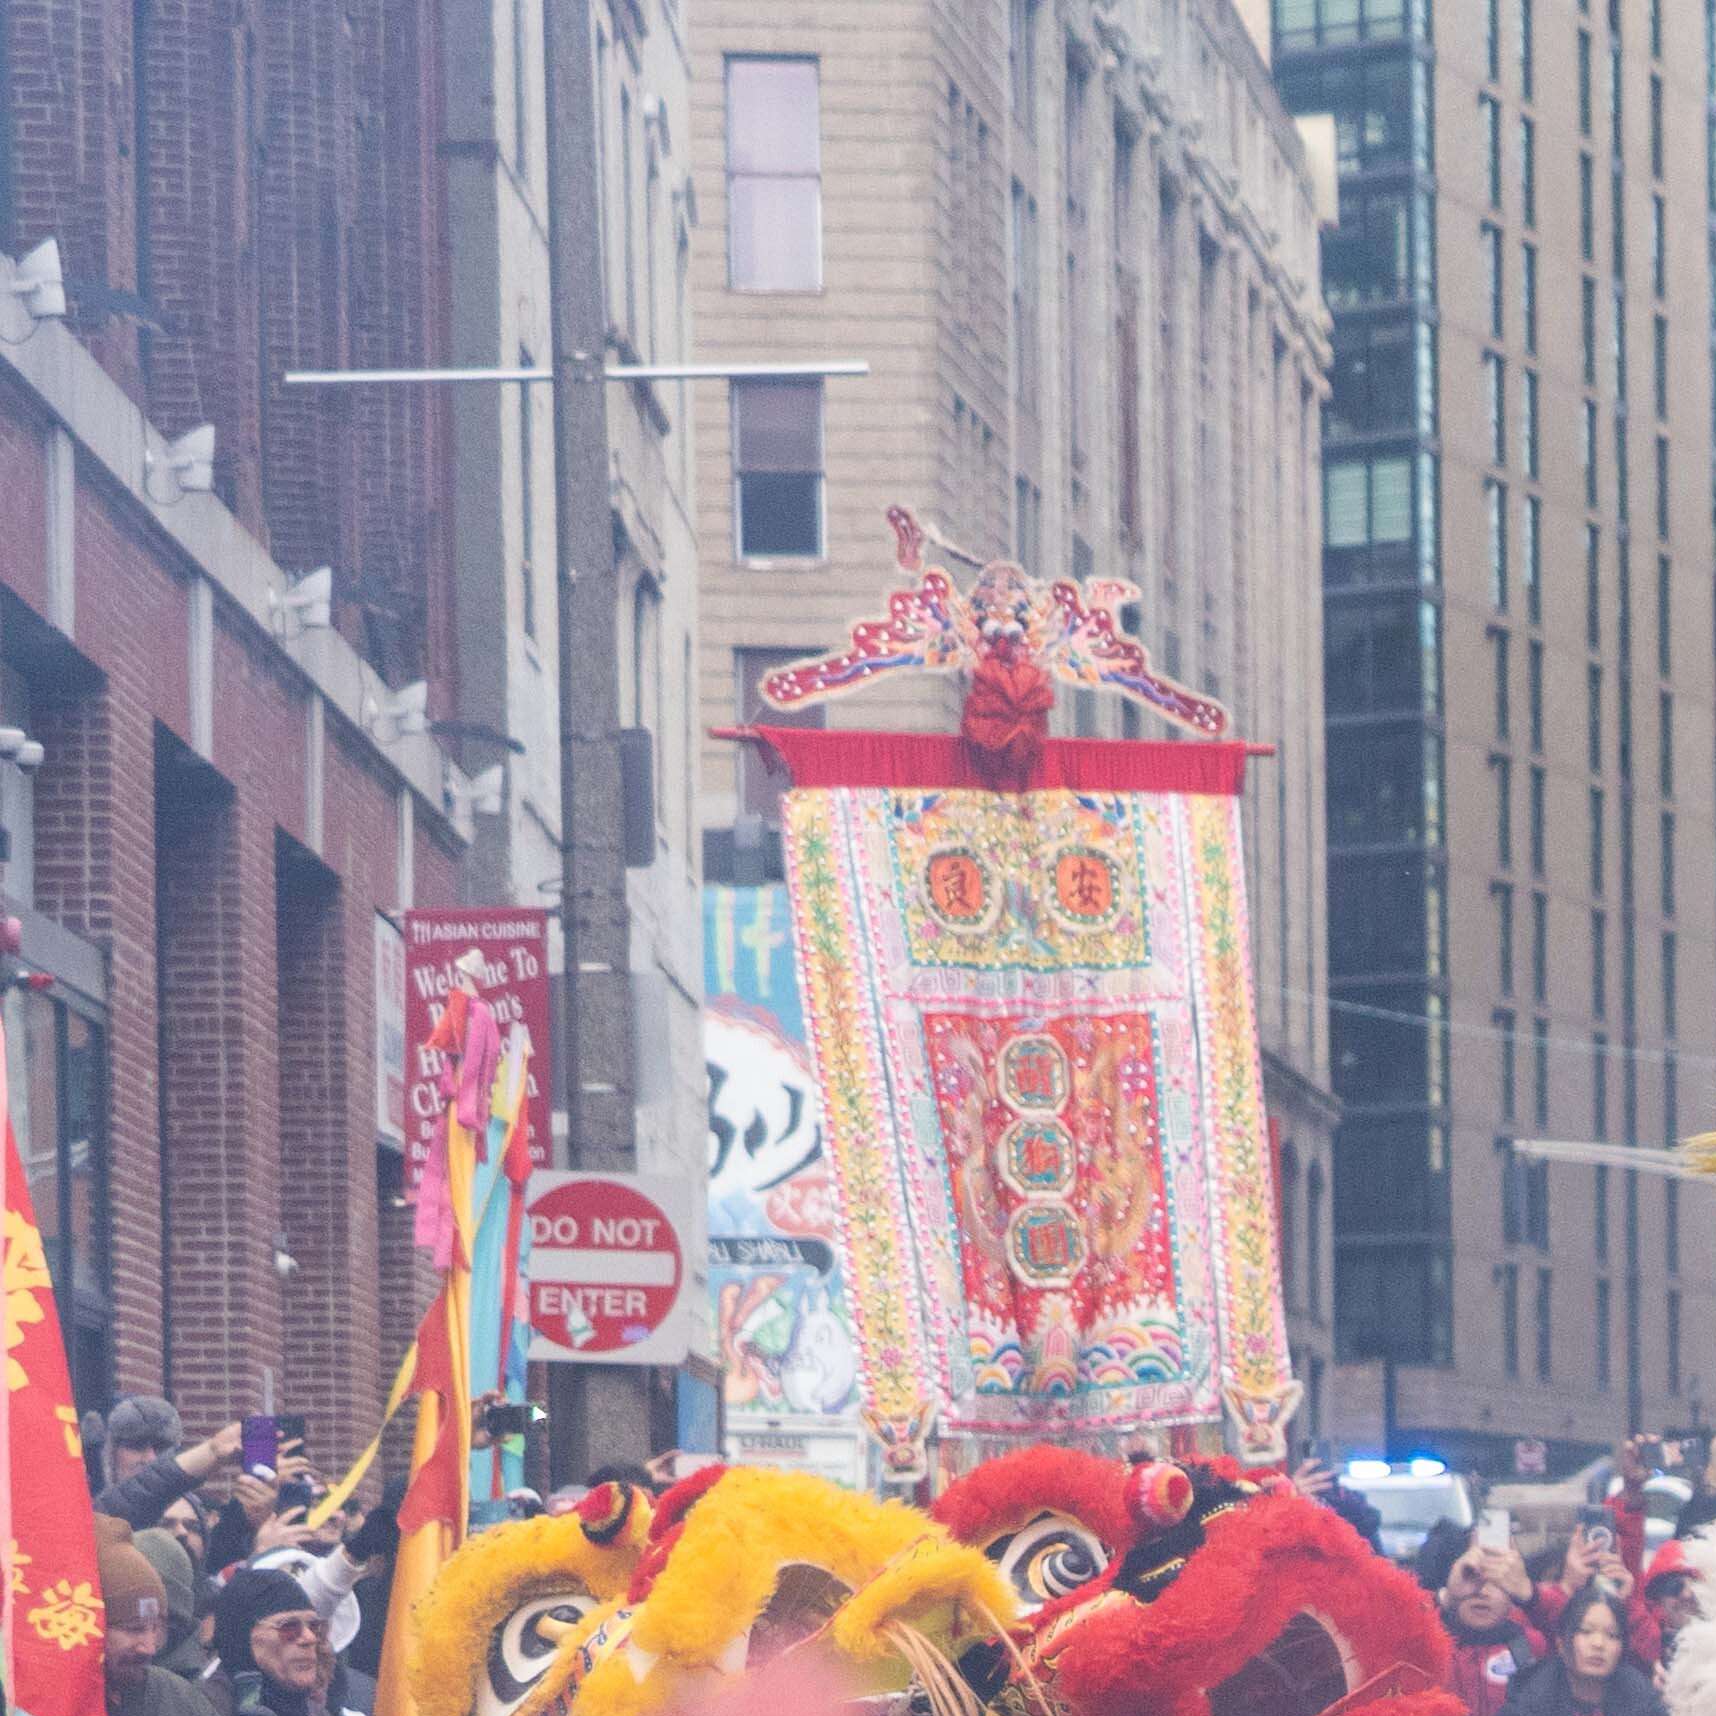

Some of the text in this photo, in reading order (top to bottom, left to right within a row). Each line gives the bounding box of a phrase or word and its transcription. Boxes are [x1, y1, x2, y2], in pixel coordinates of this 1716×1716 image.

[432, 920, 541, 941] ASIAN CUISINE
[510, 946, 539, 982] To
[531, 1214, 661, 1247] DO NOT
[538, 1286, 648, 1317] ENTER
